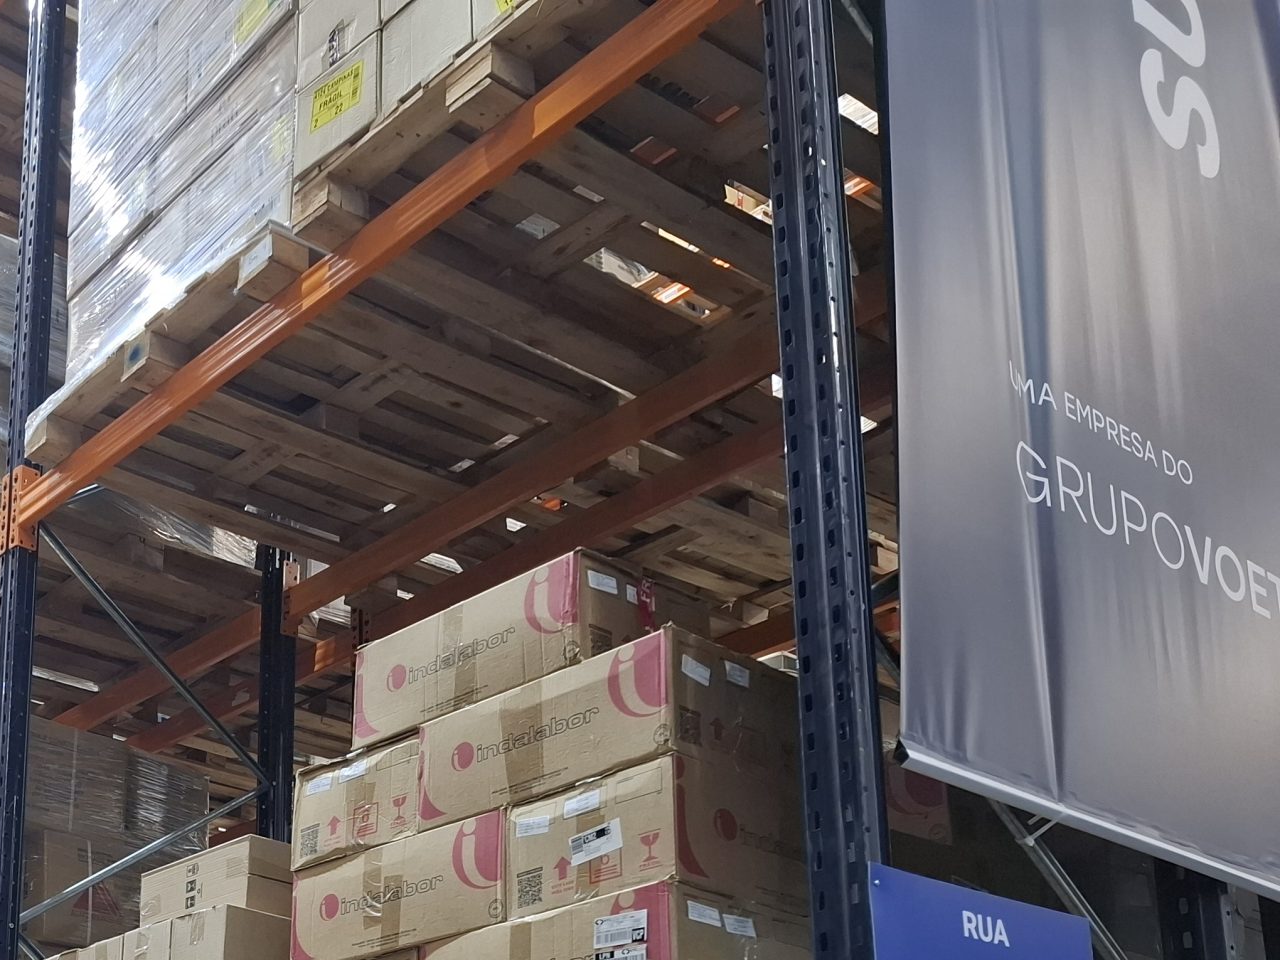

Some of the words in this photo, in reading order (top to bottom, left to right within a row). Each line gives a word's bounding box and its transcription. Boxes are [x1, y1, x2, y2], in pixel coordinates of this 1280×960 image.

[1008, 360, 1057, 411] UMA
[1065, 392, 1157, 468] EMPRESA
[1161, 450, 1194, 485] DO
[408, 626, 516, 685] indalabor
[476, 706, 600, 764] indalabor
[340, 874, 444, 917] indalabor
[962, 910, 1010, 947] RUA
